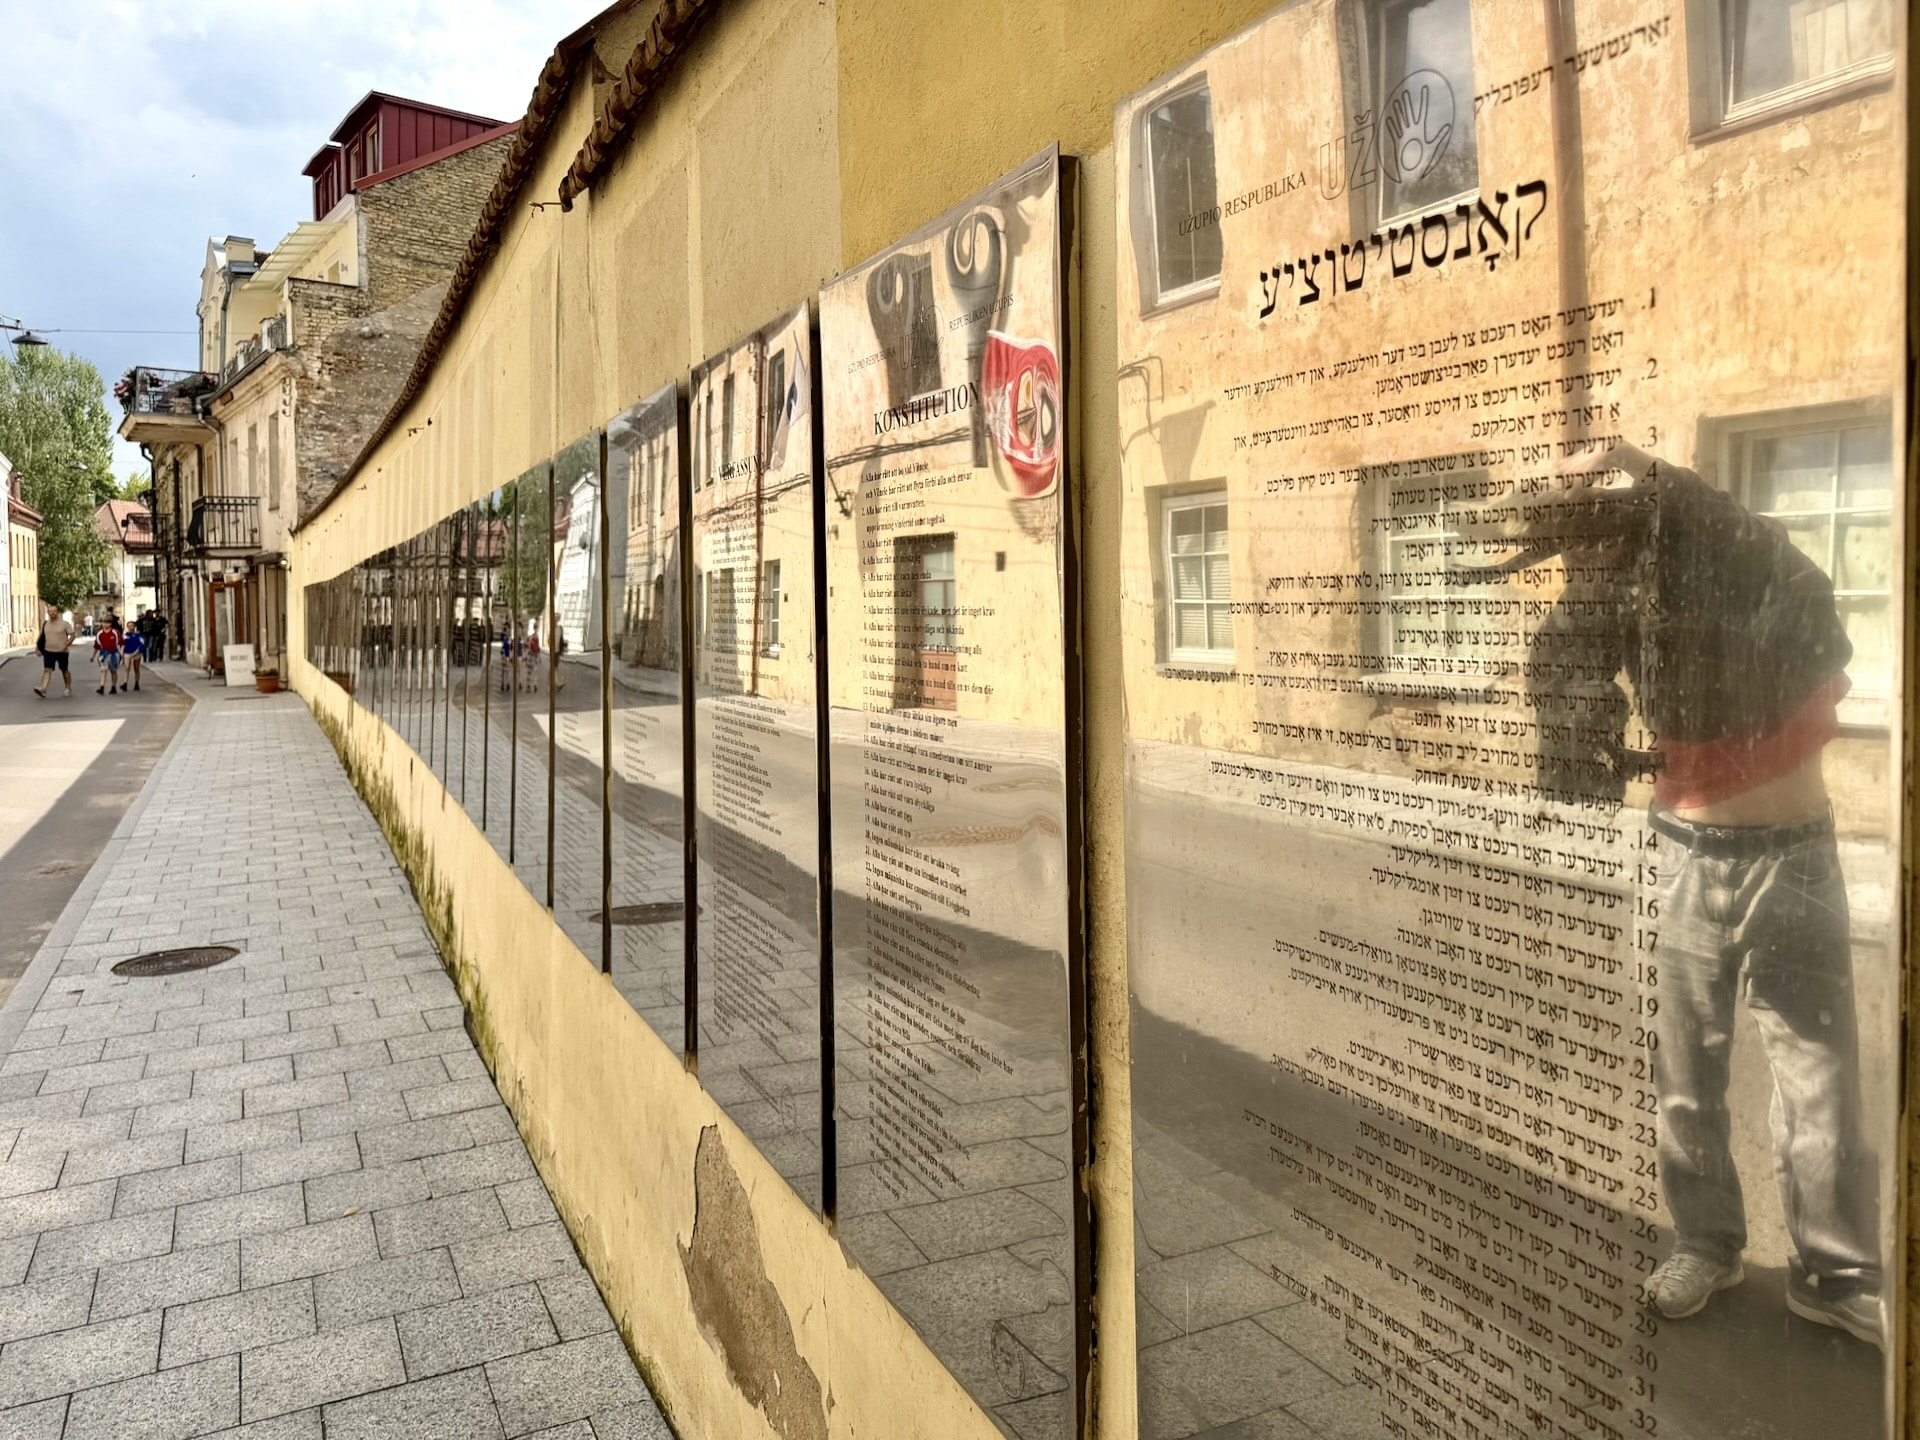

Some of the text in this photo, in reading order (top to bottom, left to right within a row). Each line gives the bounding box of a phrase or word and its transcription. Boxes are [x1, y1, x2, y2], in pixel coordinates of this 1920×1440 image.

[1177, 171, 1307, 237] UŽUPIO RESPUBLIKA
[1258, 180, 1549, 319] קאָנסטיטוציע
[1556, 298, 1623, 326] יעדערער
[1429, 331, 1458, 358] לעבן
[1462, 331, 1475, 348] צו
[1480, 323, 1515, 344] רעכט
[1382, 348, 1404, 365] דער
[1493, 347, 1540, 374] יעדערן
[1546, 339, 1585, 360] רעכט
[1254, 373, 1292, 396] ווילענקע
[1296, 371, 1305, 383] די
[1309, 366, 1324, 385] און
[1555, 368, 1621, 393] יעדערער
[1224, 384, 1250, 400] ווידער
[1464, 393, 1477, 408] צו
[1482, 386, 1517, 406] רעכט
[873, 380, 980, 436] KONSTITUTION
[1425, 395, 1460, 416] הייסע
[1361, 411, 1373, 426] צו
[1542, 410, 1567, 427] מיט
[1234, 435, 1246, 451] און
[1556, 434, 1622, 456] יעדערער
[1461, 452, 1475, 468] צו
[1479, 448, 1514, 466] רעכט
[1298, 474, 1315, 491] קיין
[1319, 471, 1334, 485] ניט
[1288, 799, 1307, 816] קיין
[1308, 802, 1324, 817] ניט
[1464, 832, 1478, 849] צו
[1483, 836, 1518, 858] רעכט
[1557, 847, 1623, 877] יעדערער
[1468, 948, 1482, 965] צו
[1485, 953, 1521, 978] רעכט
[1557, 974, 1622, 1005] יעדערער
[1393, 1137, 1415, 1159] דעם
[1307, 1166, 1321, 1185] און
[1385, 1160, 1435, 1197] אייגענעם
[1325, 1176, 1376, 1215] שוועסטער
[1438, 1187, 1465, 1212] מיטן
[1469, 1200, 1500, 1230] טיילן
[1504, 1189, 1563, 1228] יעדערער
[1504, 1220, 1523, 1242] זיך
[1569, 1221, 1590, 1244] זיך
[1337, 1233, 1382, 1271] אייגענער
[1529, 1232, 1553, 1258] קען
[1463, 1252, 1477, 1272] צו
[1558, 1247, 1623, 1289] יעדערער
[1386, 1263, 1408, 1286] דער
[1482, 1262, 1516, 1295] רעכט
[1439, 1294, 1484, 1332] אחריות
[1488, 1323, 1501, 1342] די
[1557, 1304, 1622, 1348] יעדערער
[1557, 1364, 1623, 1411] יעדערער
